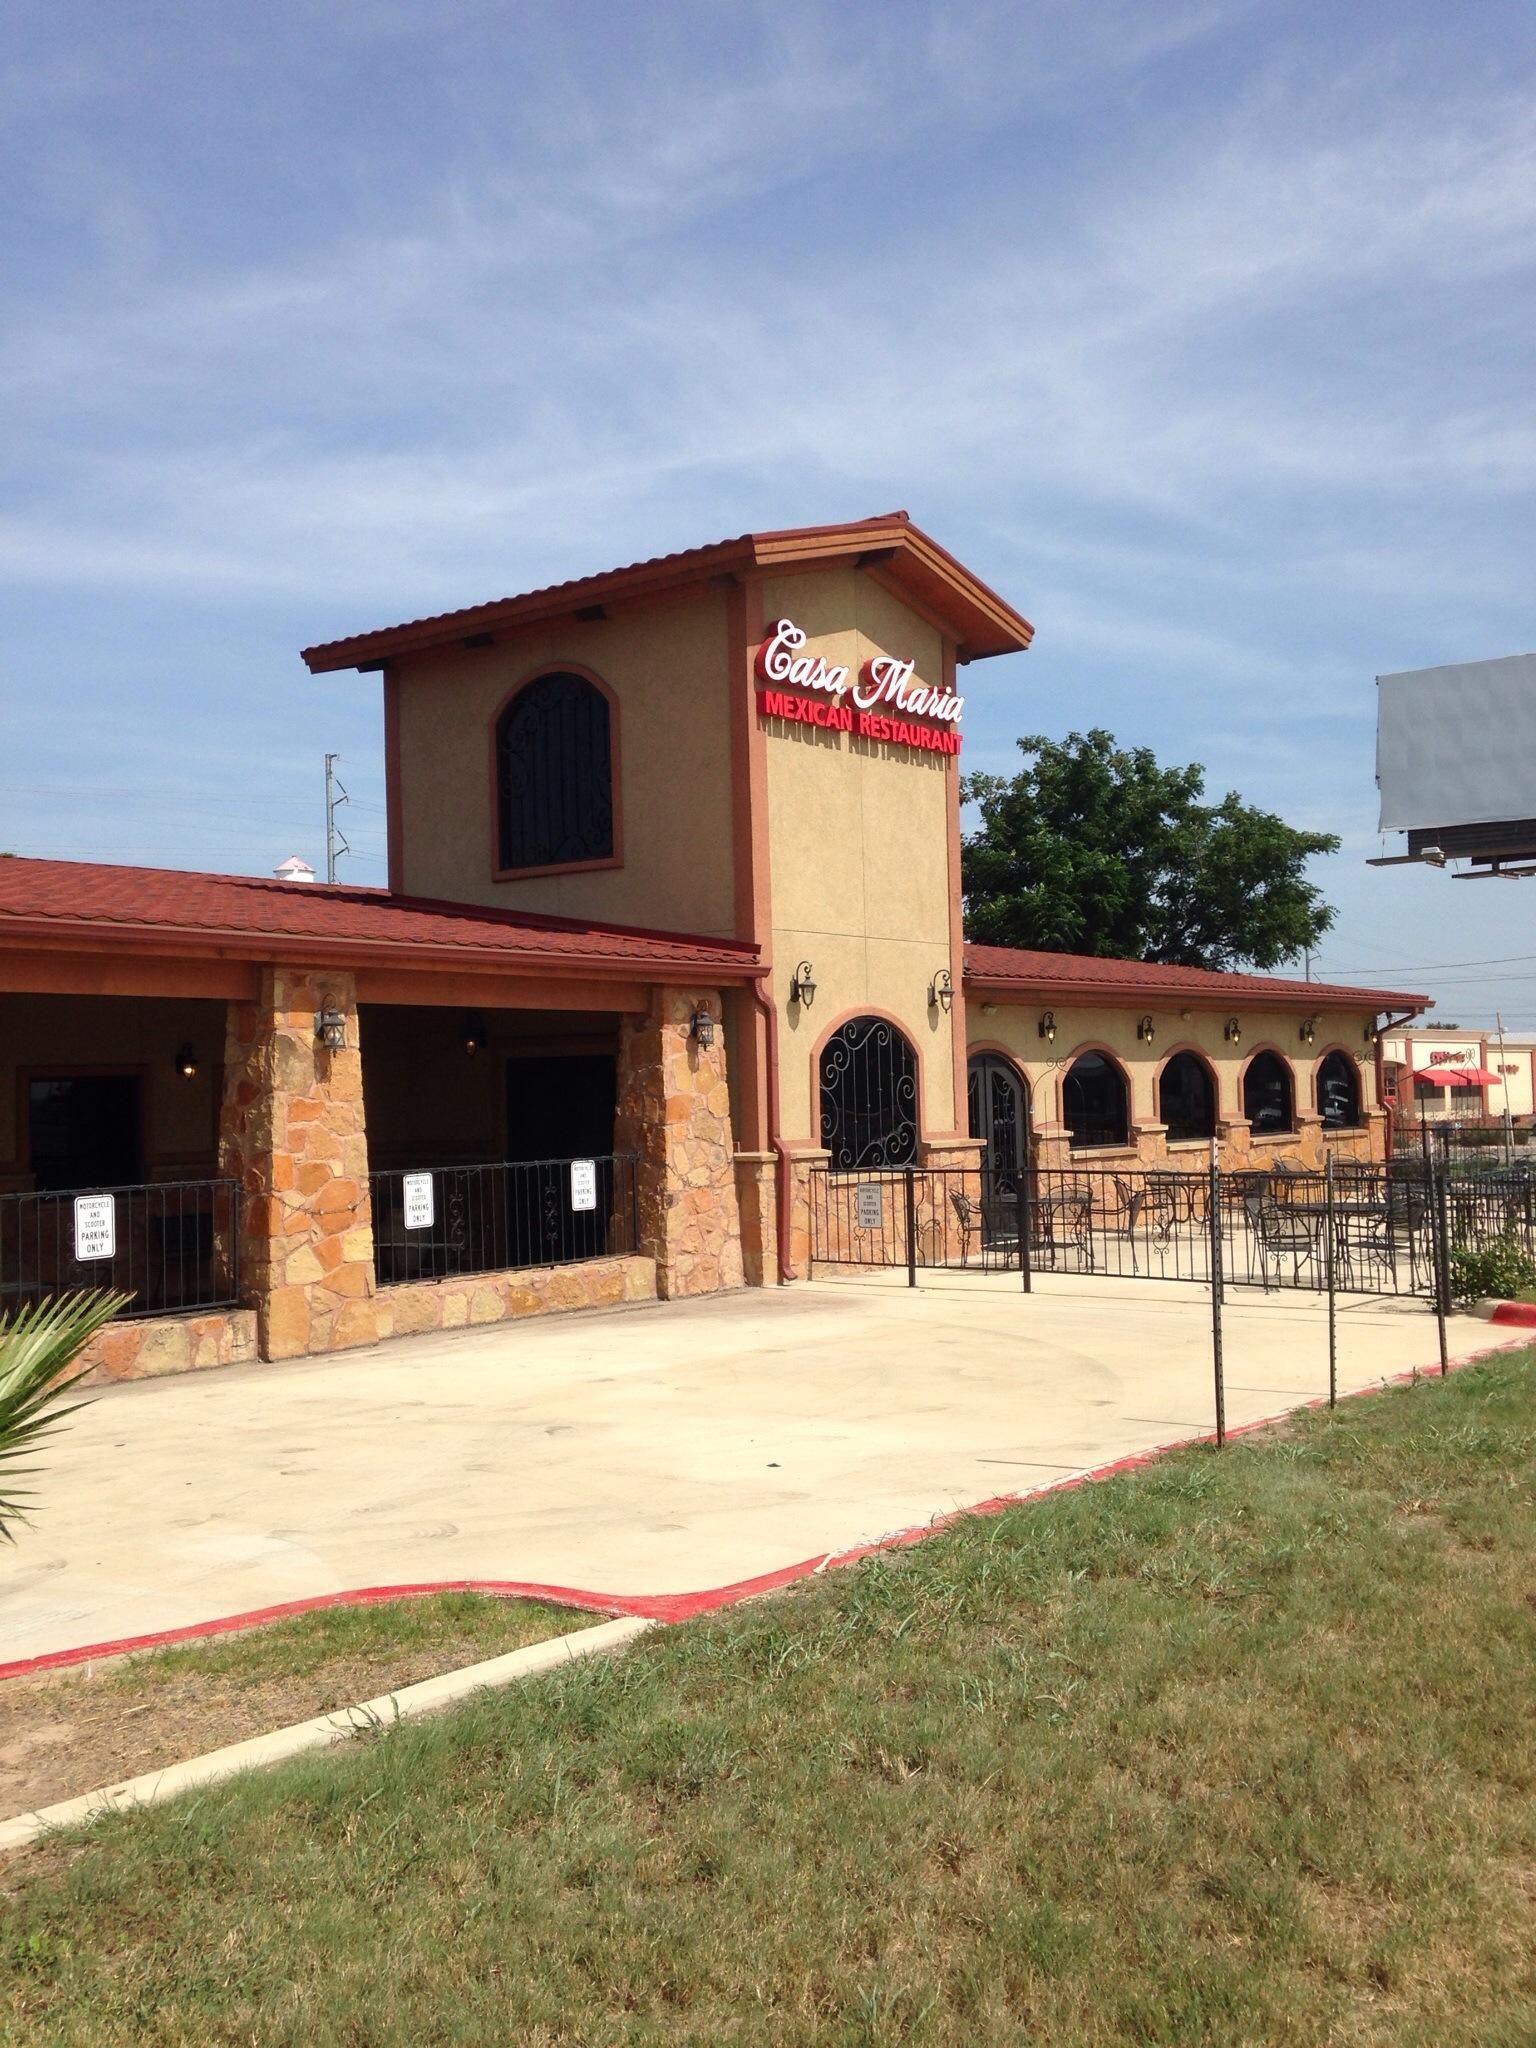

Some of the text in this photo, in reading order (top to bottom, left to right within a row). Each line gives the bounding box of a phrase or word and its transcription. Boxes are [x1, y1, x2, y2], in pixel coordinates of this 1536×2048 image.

[763, 618, 965, 723] Casa Maria
[765, 690, 964, 755] MEXICAN RESTAURANT
[79, 1200, 110, 1210] MOTORCYCLE
[408, 1203, 430, 1213] PARKING
[84, 1219, 106, 1228] SCOOTER
[81, 1230, 109, 1241] PARKING
[86, 1243, 104, 1253] ONLY
